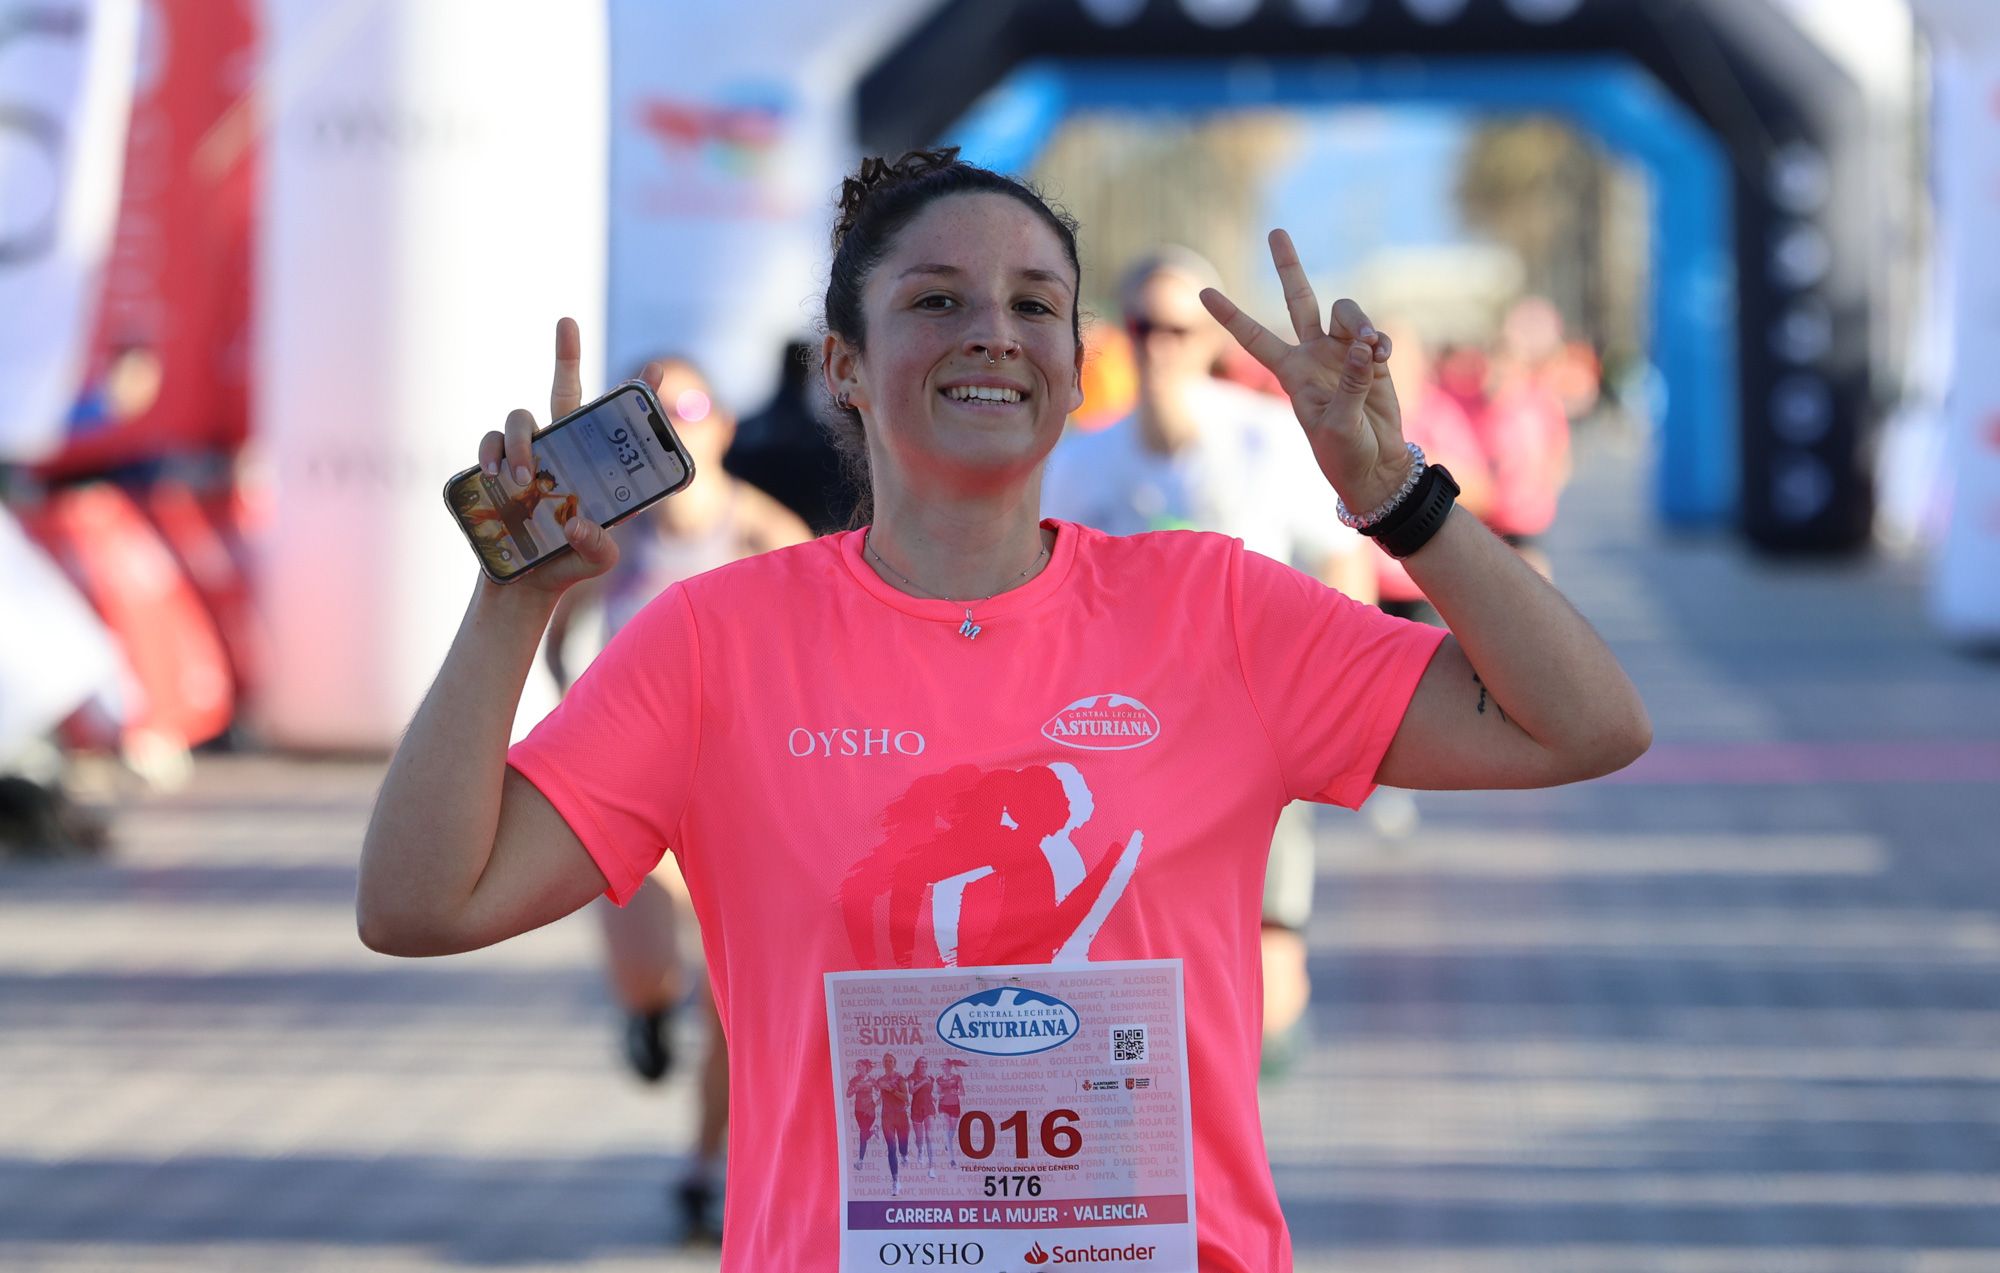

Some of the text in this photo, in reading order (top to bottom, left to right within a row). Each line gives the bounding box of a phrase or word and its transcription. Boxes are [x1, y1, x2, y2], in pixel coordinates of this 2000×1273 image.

[607, 428, 645, 477] 9:31
[1052, 717, 1153, 737] ASTURIANA
[788, 727, 926, 757] OYSHO
[854, 1016, 871, 1026] TU
[874, 1015, 923, 1026] DORSAL
[948, 1013, 1069, 1039] ASTURIANA
[859, 1027, 924, 1045] SUMA
[1047, 1071, 1058, 1079] DE
[1061, 1070, 1073, 1078] LA
[958, 1109, 1083, 1159] 016
[961, 1163, 996, 1172] TELÉFONO
[1048, 1163, 1080, 1171] GÉNERO
[984, 1175, 1042, 1197] 5176
[885, 1207, 954, 1224] CARRERA
[959, 1207, 979, 1223] DE
[983, 1207, 1001, 1223] LA
[1006, 1205, 1058, 1223] MUJER
[1073, 1203, 1148, 1221] VALENCIA
[879, 1243, 984, 1266] OYSHO
[1053, 1243, 1156, 1263] Santander
